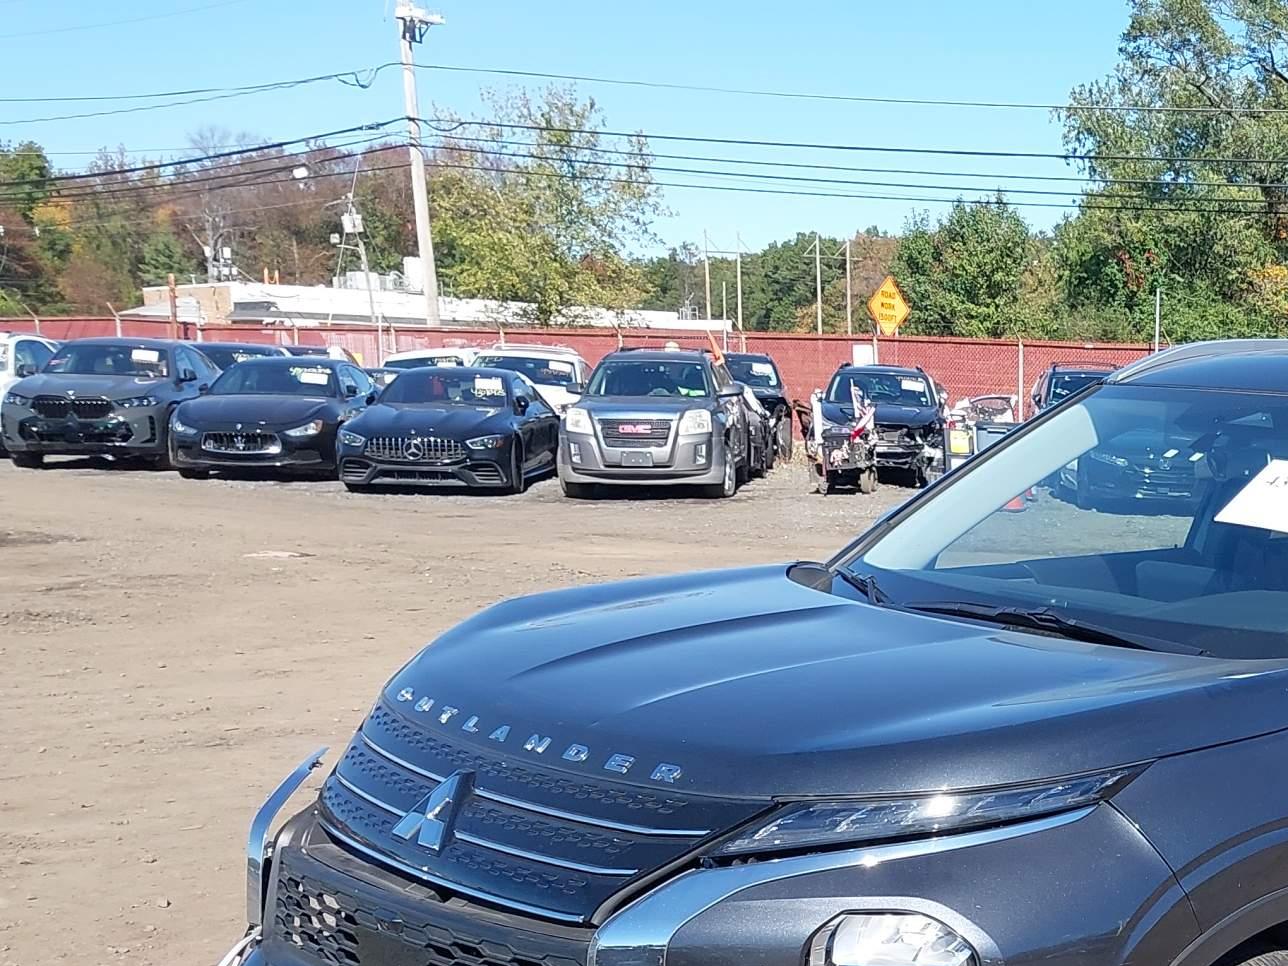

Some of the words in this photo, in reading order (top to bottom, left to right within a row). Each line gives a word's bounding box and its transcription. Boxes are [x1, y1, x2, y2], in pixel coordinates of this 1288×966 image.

[880, 290, 897, 299] ROAD
[880, 302, 895, 311] WORK
[618, 424, 652, 434] GMC
[397, 686, 682, 784] OUTLANDER
